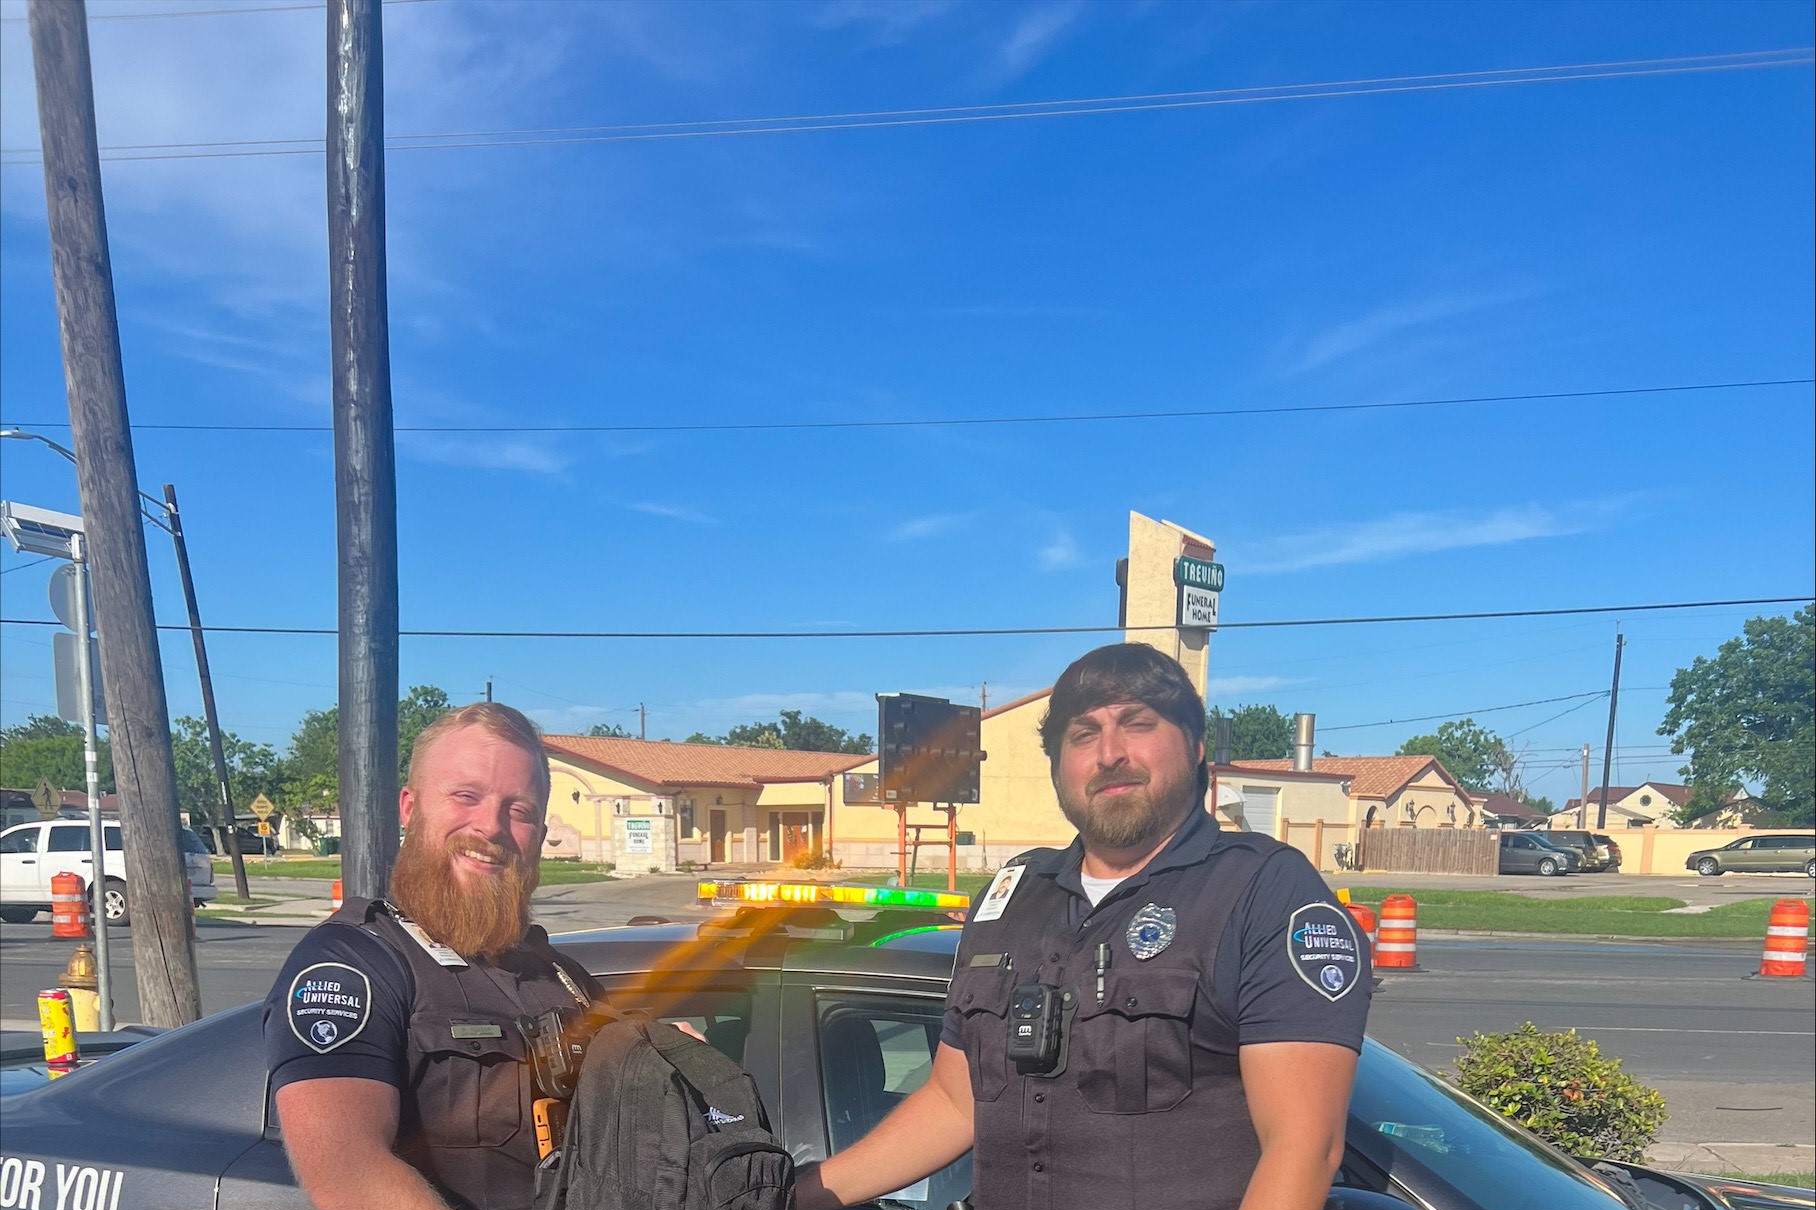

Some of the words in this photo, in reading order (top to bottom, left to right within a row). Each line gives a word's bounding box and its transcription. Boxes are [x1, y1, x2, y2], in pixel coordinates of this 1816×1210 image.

[1184, 562, 1222, 586] TREVIÑO
[1187, 593, 1216, 616] FUNERAL
[1192, 609, 1211, 623] HOME
[1304, 922, 1337, 935] ALLIED
[1304, 935, 1355, 951] UNIVERSAL
[1300, 953, 1330, 961] SECURITY
[304, 980, 340, 992] ALLIED
[303, 992, 361, 1008] UNIVERSAL
[296, 1008, 325, 1016] SECURITY
[326, 1009, 358, 1019] SERVICES
[1, 1157, 46, 1210] OR
